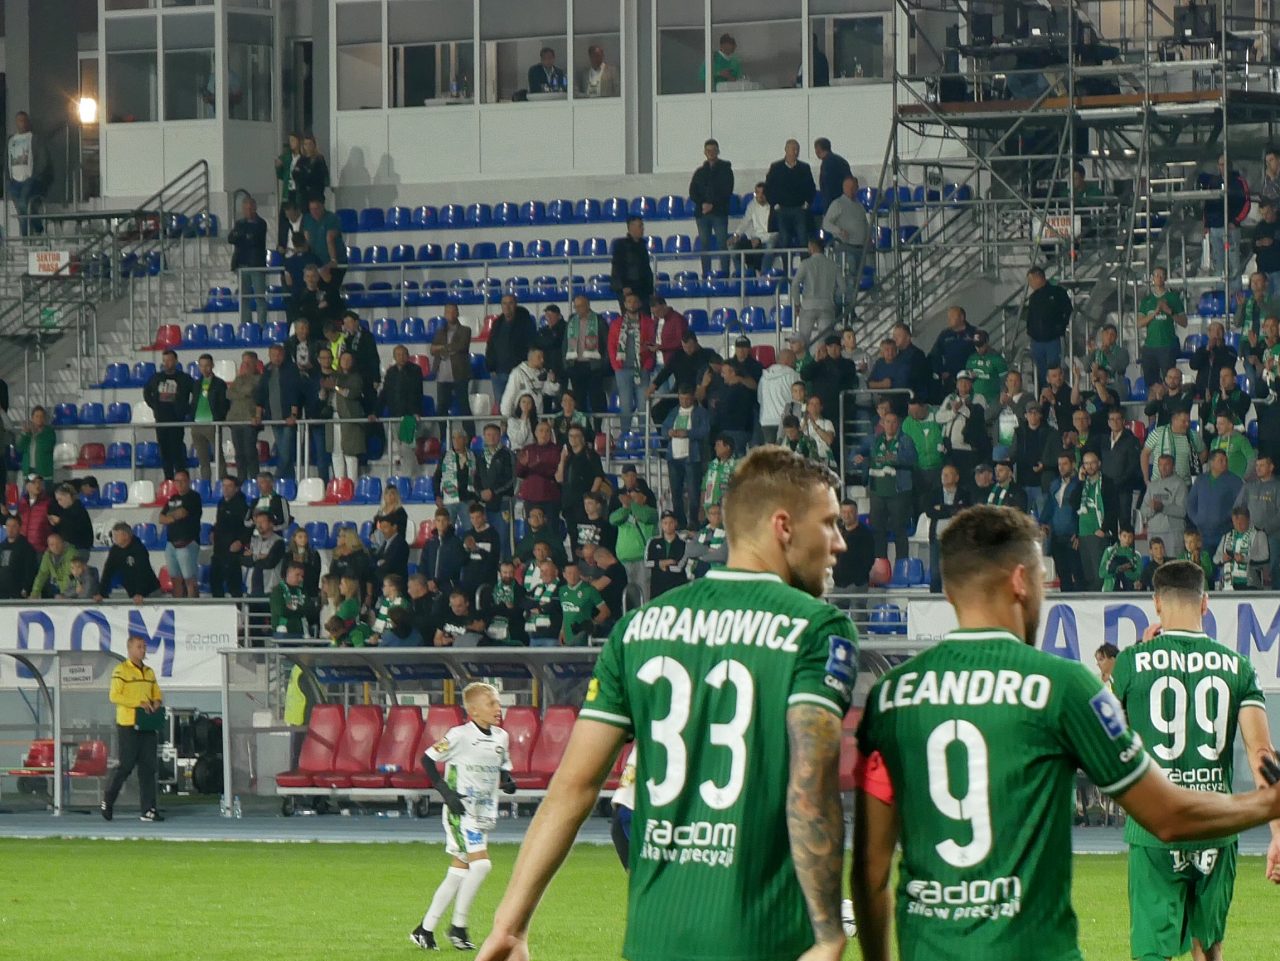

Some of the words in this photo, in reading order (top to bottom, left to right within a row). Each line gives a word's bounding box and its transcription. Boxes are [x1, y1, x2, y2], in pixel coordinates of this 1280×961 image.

[0, 609, 176, 679] DOM
[622, 606, 809, 651] ABRAMOWICZ
[1135, 650, 1238, 675] RONDON
[879, 669, 1051, 713] LEANDRO
[636, 655, 754, 810] 33
[1150, 675, 1231, 761] 99
[926, 719, 992, 868] 9
[644, 819, 737, 848] radom
[906, 877, 1021, 904] radom
